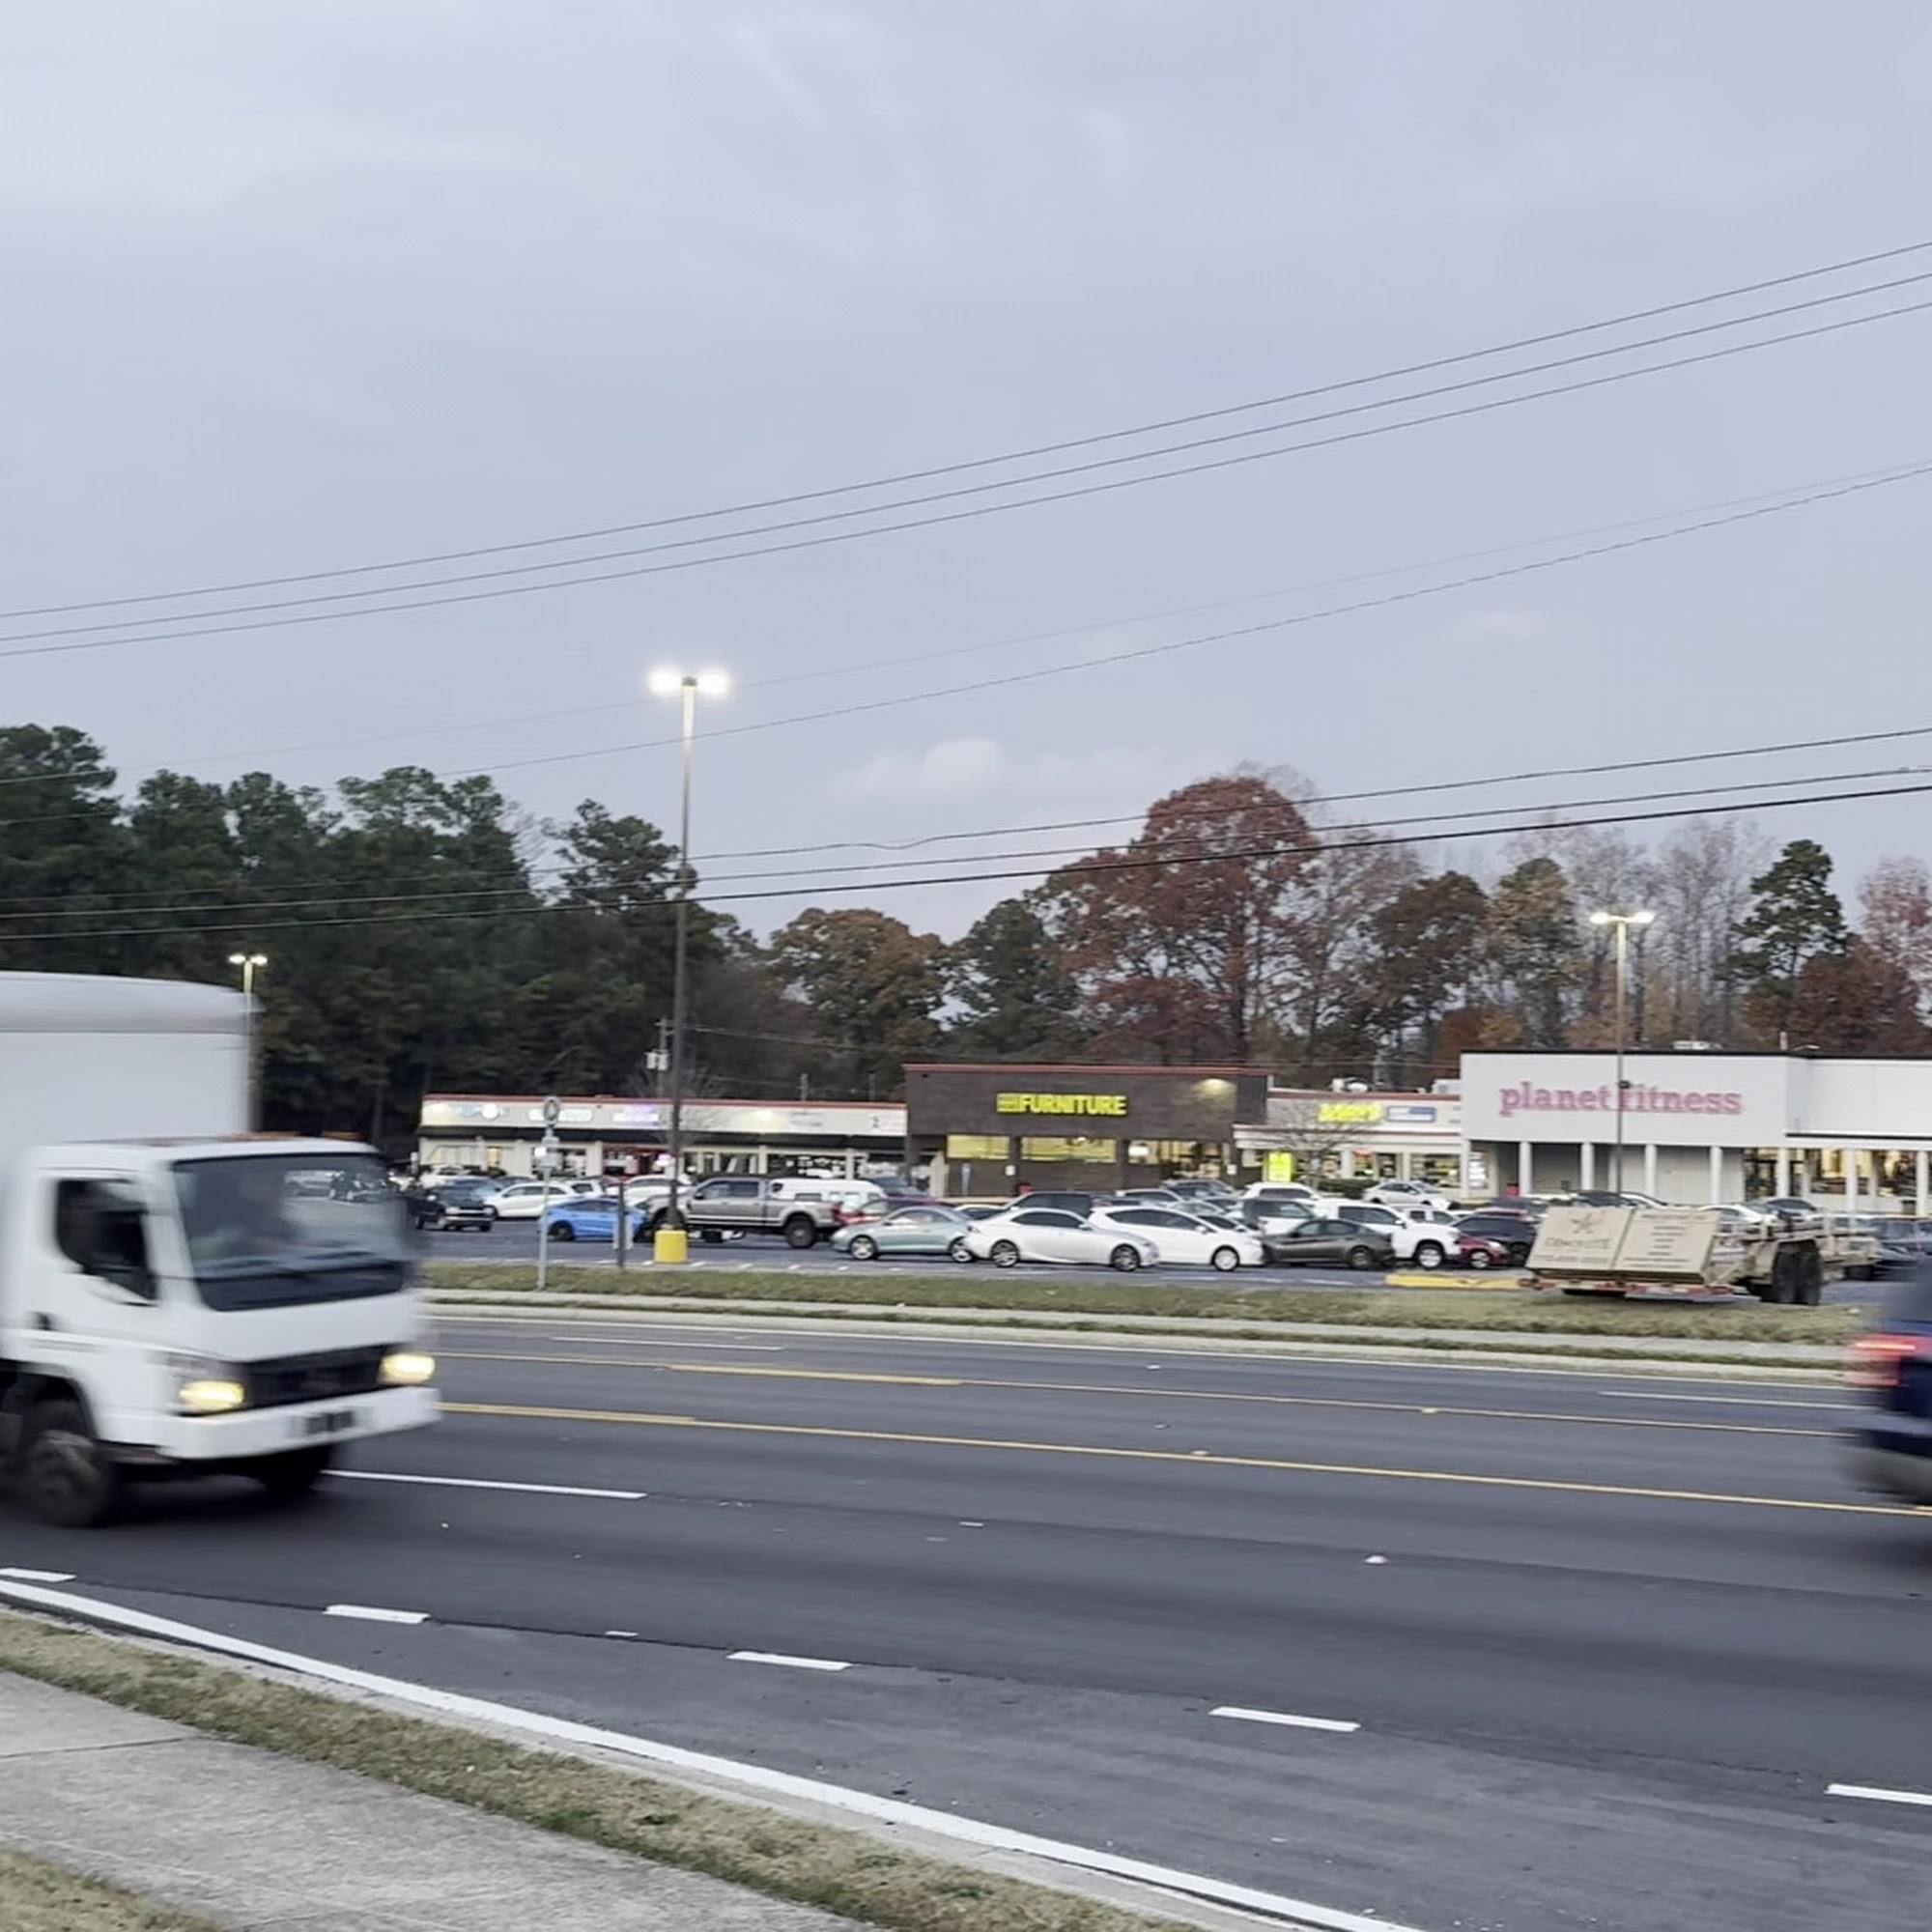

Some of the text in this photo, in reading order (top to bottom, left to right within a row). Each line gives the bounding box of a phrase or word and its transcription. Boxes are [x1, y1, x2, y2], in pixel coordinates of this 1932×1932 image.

[1019, 1094, 1127, 1115] FURNITURE
[1499, 1081, 1742, 1117] planet fitness
